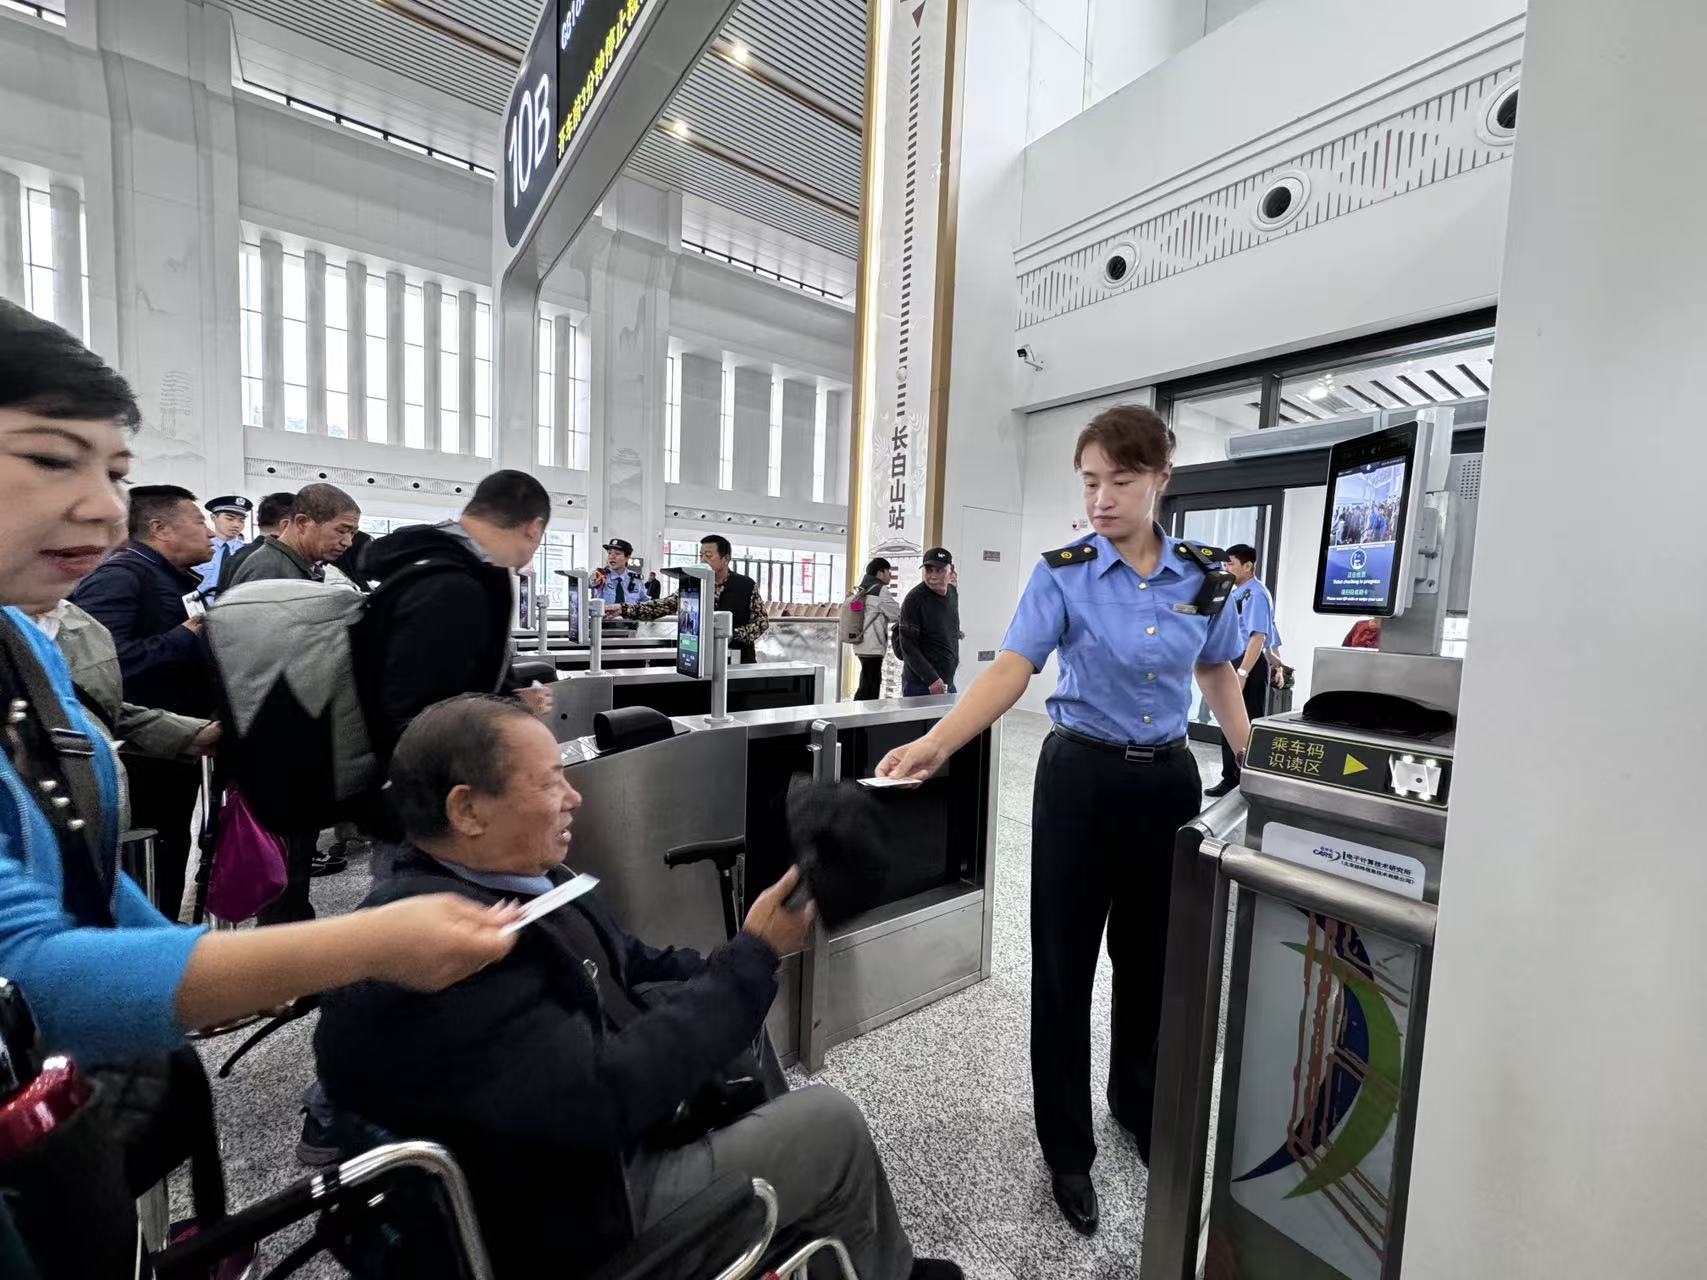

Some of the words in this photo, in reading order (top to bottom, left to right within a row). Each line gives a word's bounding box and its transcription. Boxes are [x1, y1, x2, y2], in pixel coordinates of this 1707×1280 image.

[558, 0, 642, 159] 开车前3分钟停止检
[508, 73, 551, 208] 10B
[888, 424, 909, 530] 长白山站
[1269, 752, 1323, 777] 识读区
[1271, 736, 1324, 759] 乘车码
[1313, 849, 1333, 860] CARS
